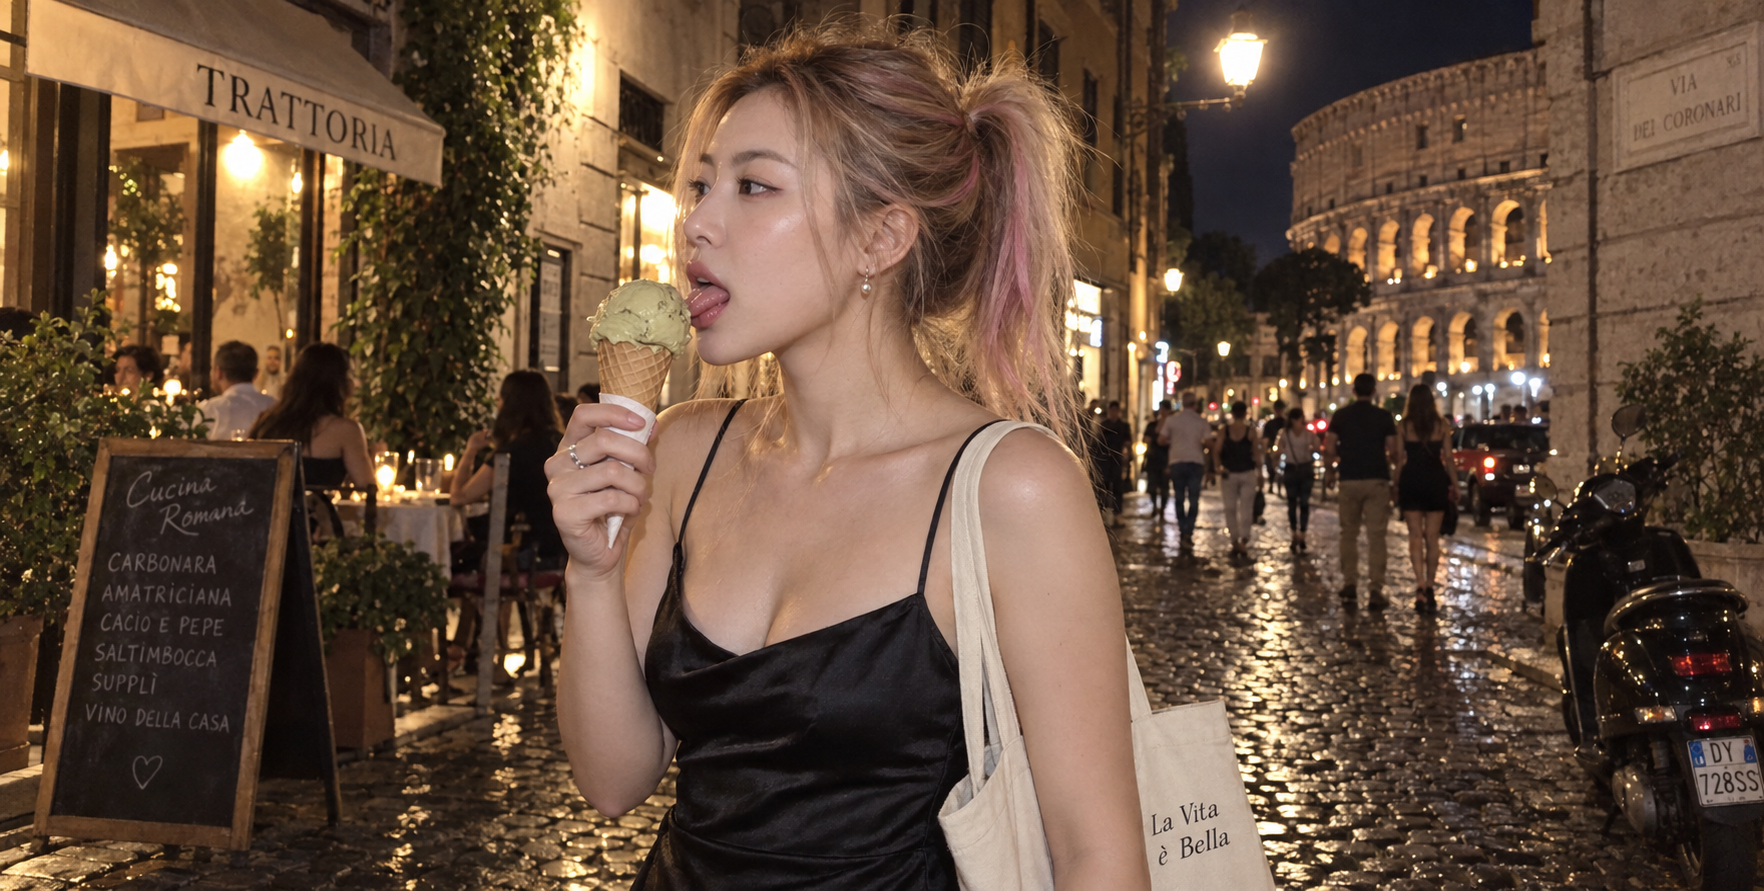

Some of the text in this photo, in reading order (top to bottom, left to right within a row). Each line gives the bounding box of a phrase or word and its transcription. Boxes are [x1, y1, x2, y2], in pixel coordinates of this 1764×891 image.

[1670, 73, 1698, 96] VIA
[197, 63, 397, 162] TRATTORIA
[1633, 92, 1742, 142] DEI CORONARI
[126, 470, 218, 509] Cucina
[108, 551, 217, 575] CARBONARA
[101, 582, 232, 607] AMATRICIANA
[100, 611, 225, 637] CACIO E PEPE
[94, 641, 217, 668] SALTIMBOCCA
[91, 672, 158, 695] SUPPLÌ
[85, 702, 230, 734] VINO DELLA CASA
[1709, 741, 1733, 763] DY
[1699, 769, 1759, 796] 728SS
[1151, 802, 1220, 836] La Vita
[1158, 827, 1231, 866] è Bella
